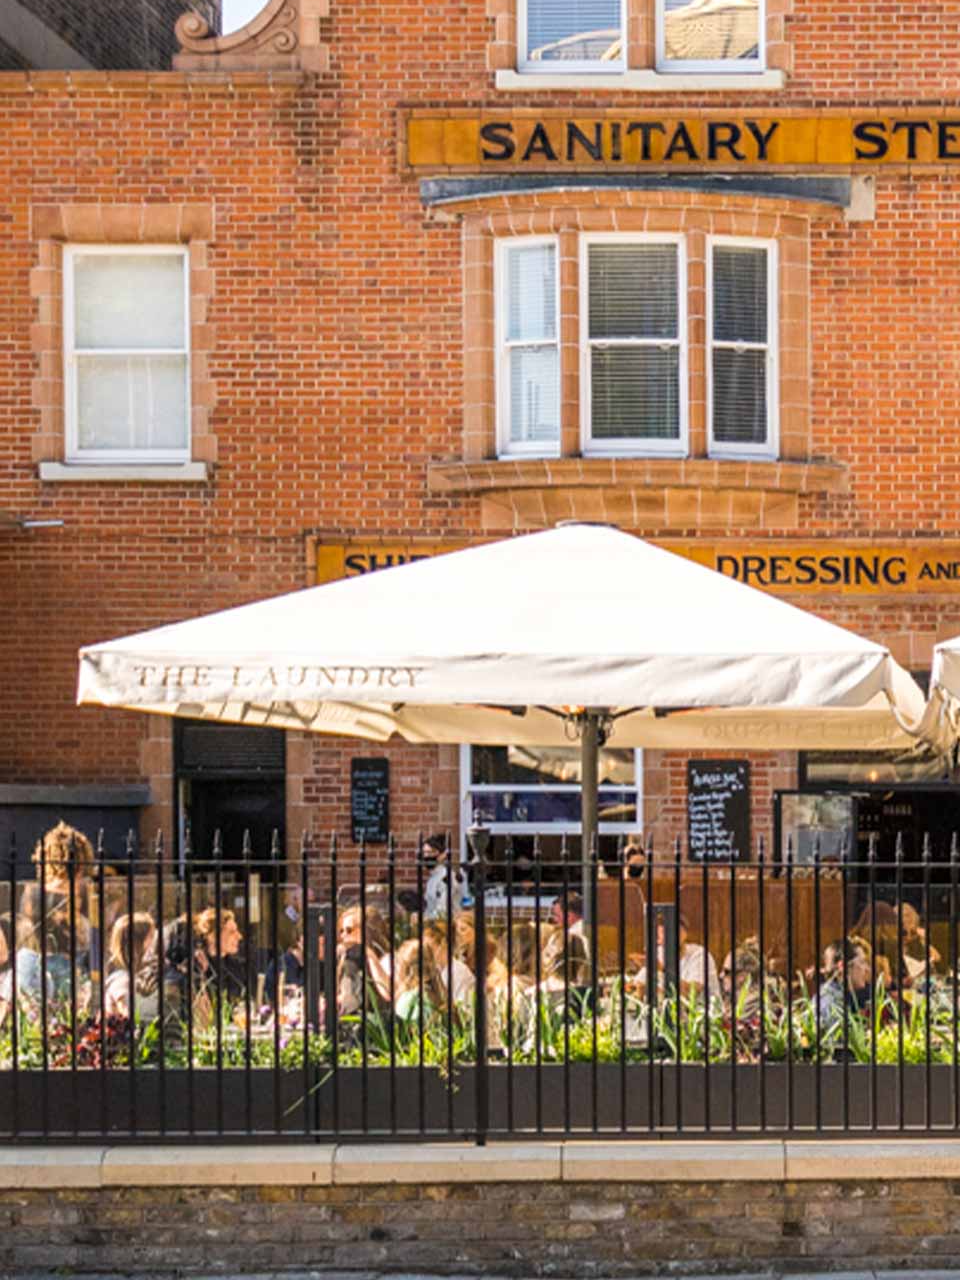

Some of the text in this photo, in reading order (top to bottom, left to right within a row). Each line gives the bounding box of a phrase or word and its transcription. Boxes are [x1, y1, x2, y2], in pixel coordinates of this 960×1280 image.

[479, 121, 780, 161] SANITARY
[716, 555, 907, 586] DRESSING
[133, 665, 424, 688] THE LAUNDRY
